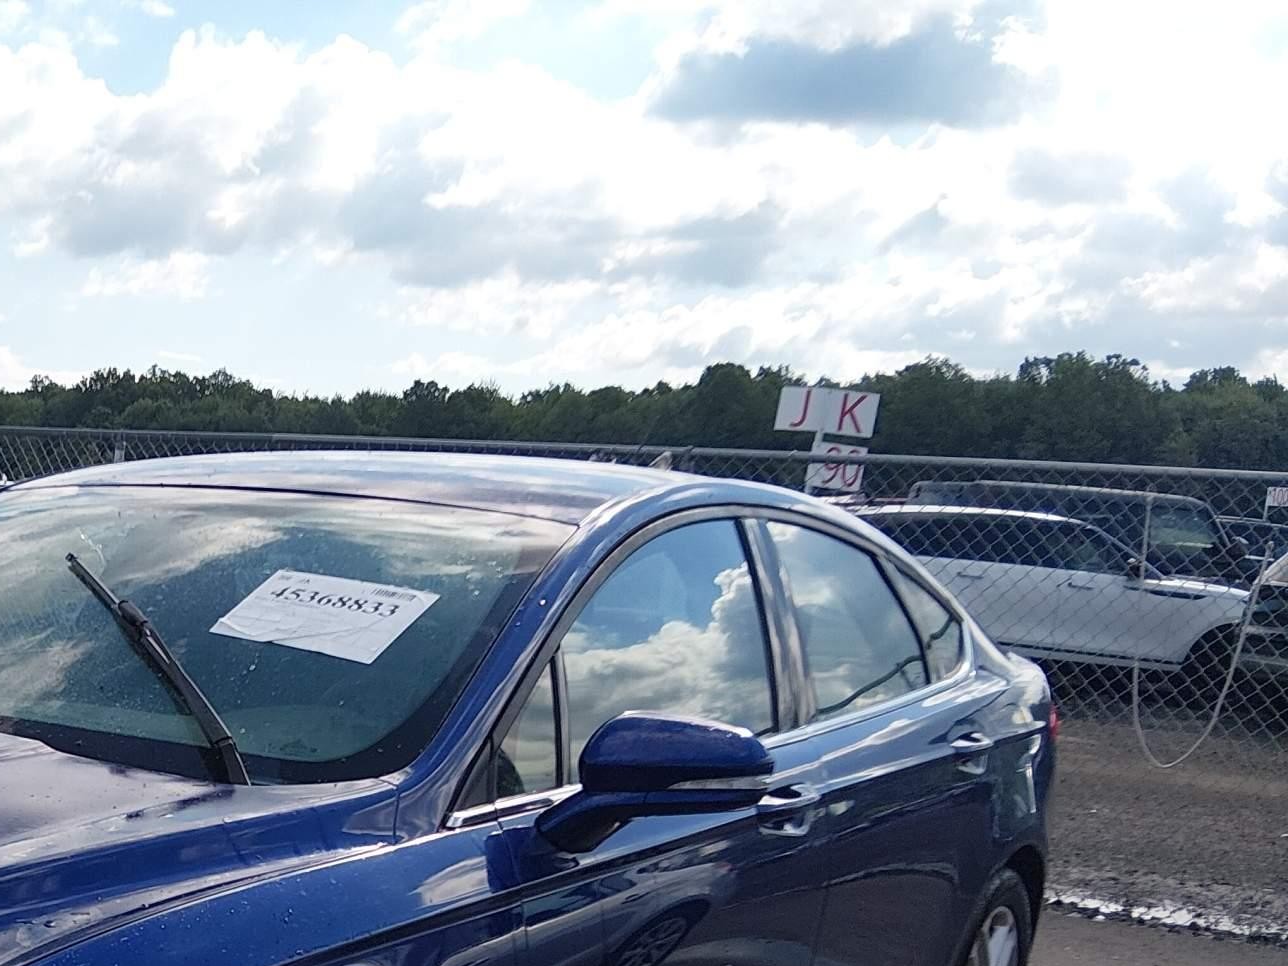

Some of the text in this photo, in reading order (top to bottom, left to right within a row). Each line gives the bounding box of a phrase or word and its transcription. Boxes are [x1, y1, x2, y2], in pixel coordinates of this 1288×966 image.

[790, 389, 868, 434] J K
[271, 587, 400, 617] 45368833
